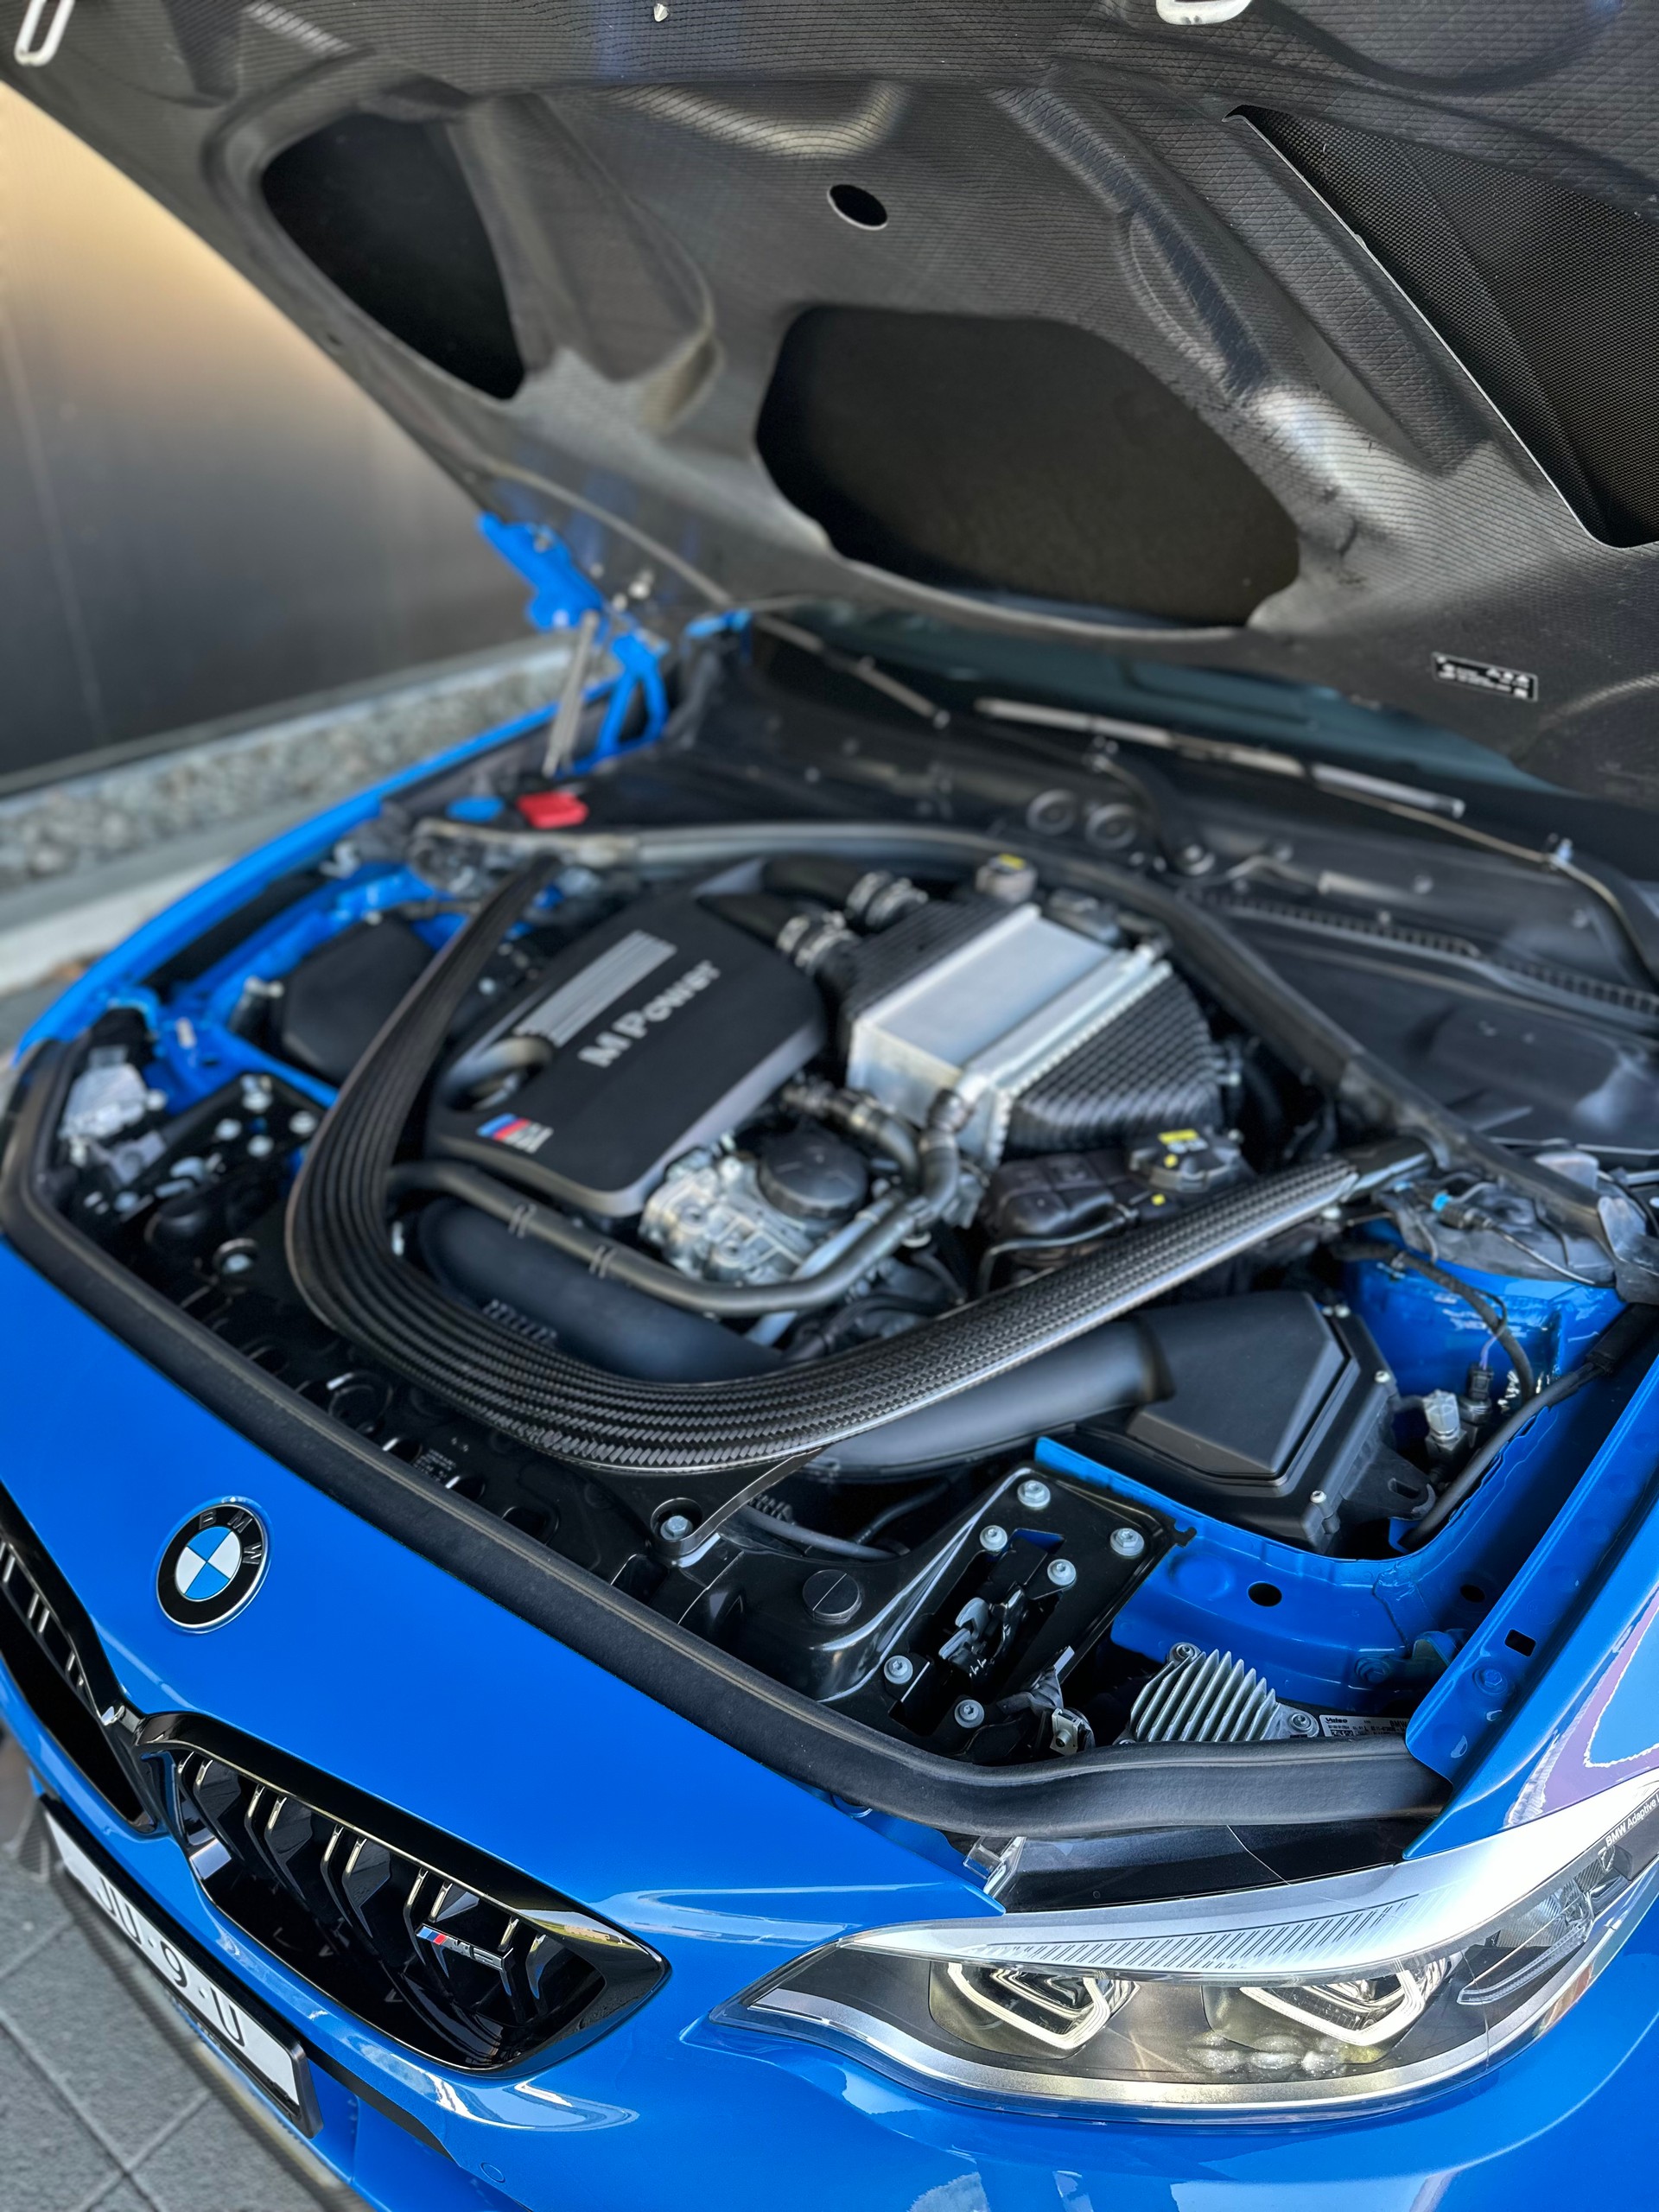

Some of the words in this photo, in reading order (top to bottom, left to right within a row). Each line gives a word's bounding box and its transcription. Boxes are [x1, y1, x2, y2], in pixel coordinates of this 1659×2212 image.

[578, 1032, 633, 1069] M
[613, 959, 721, 1039] Power
[198, 1509, 263, 1565] BMW
[1605, 1822, 1626, 1847] BMW
[1627, 1799, 1656, 1829] Adaptive
